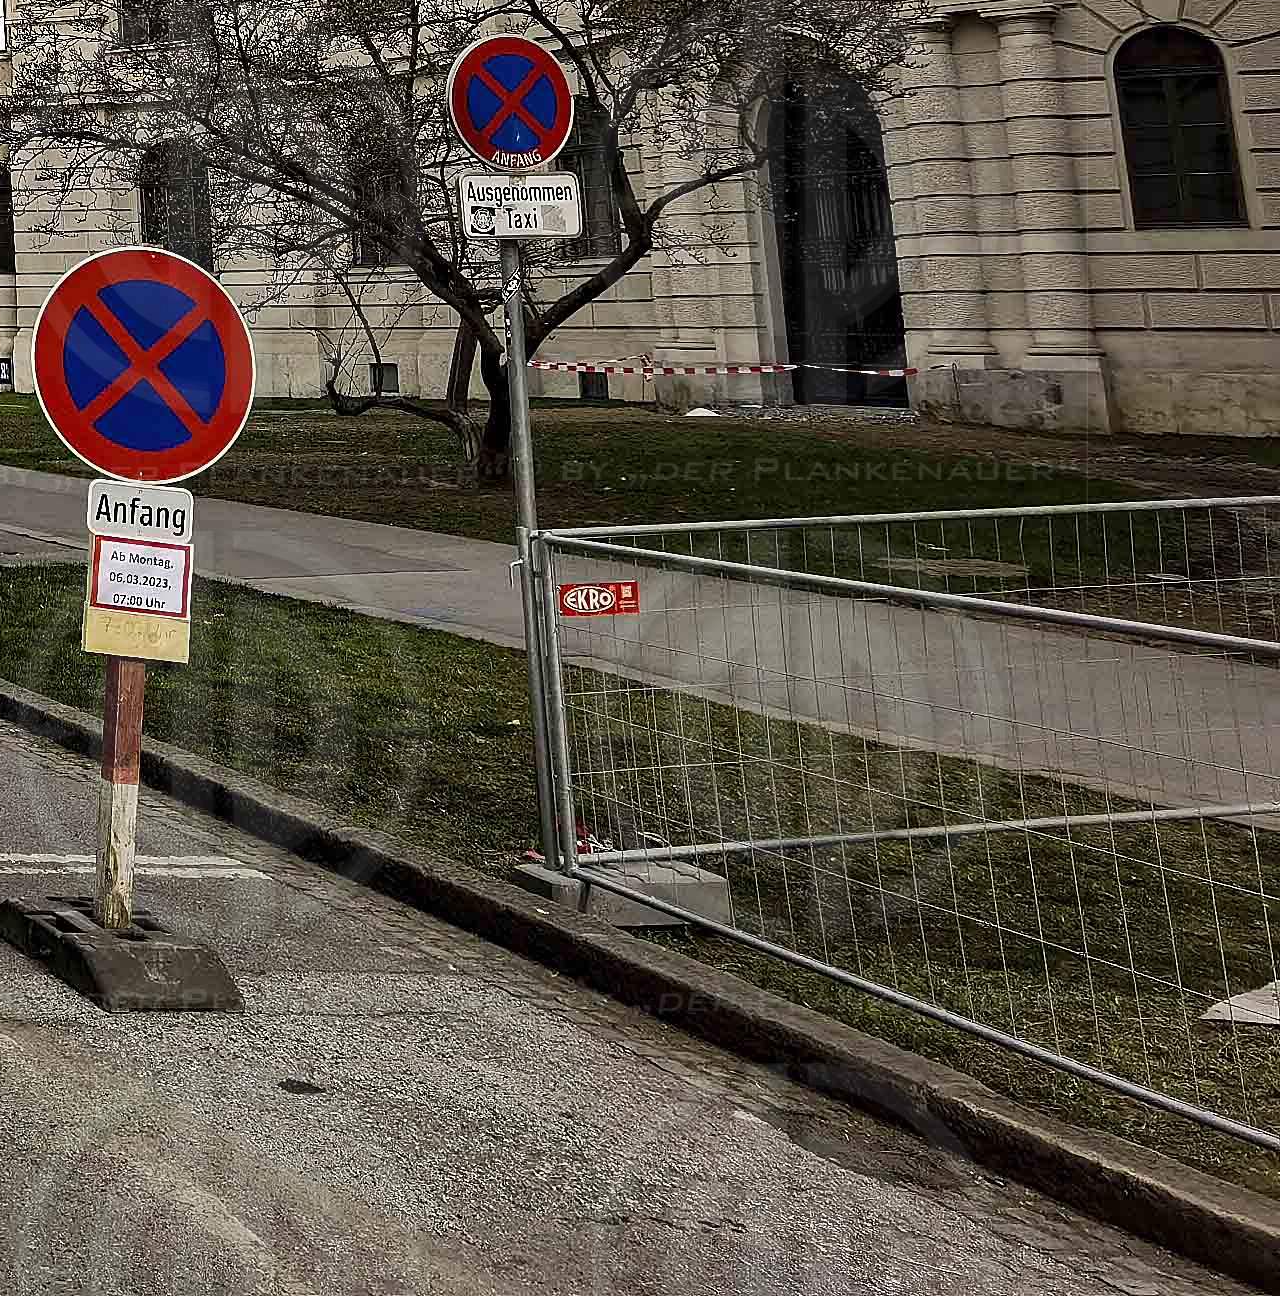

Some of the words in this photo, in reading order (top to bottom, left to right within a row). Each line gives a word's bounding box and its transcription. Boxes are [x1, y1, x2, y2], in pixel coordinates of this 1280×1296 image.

[492, 150, 542, 168] ANFANG
[467, 181, 573, 207] Ausgenommen
[504, 207, 538, 230] Taxi
[95, 493, 186, 537] Anfang
[110, 550, 125, 562] Ab
[113, 593, 142, 607] 07:00
[145, 597, 166, 609] Uhr
[566, 588, 611, 610] EKRO
